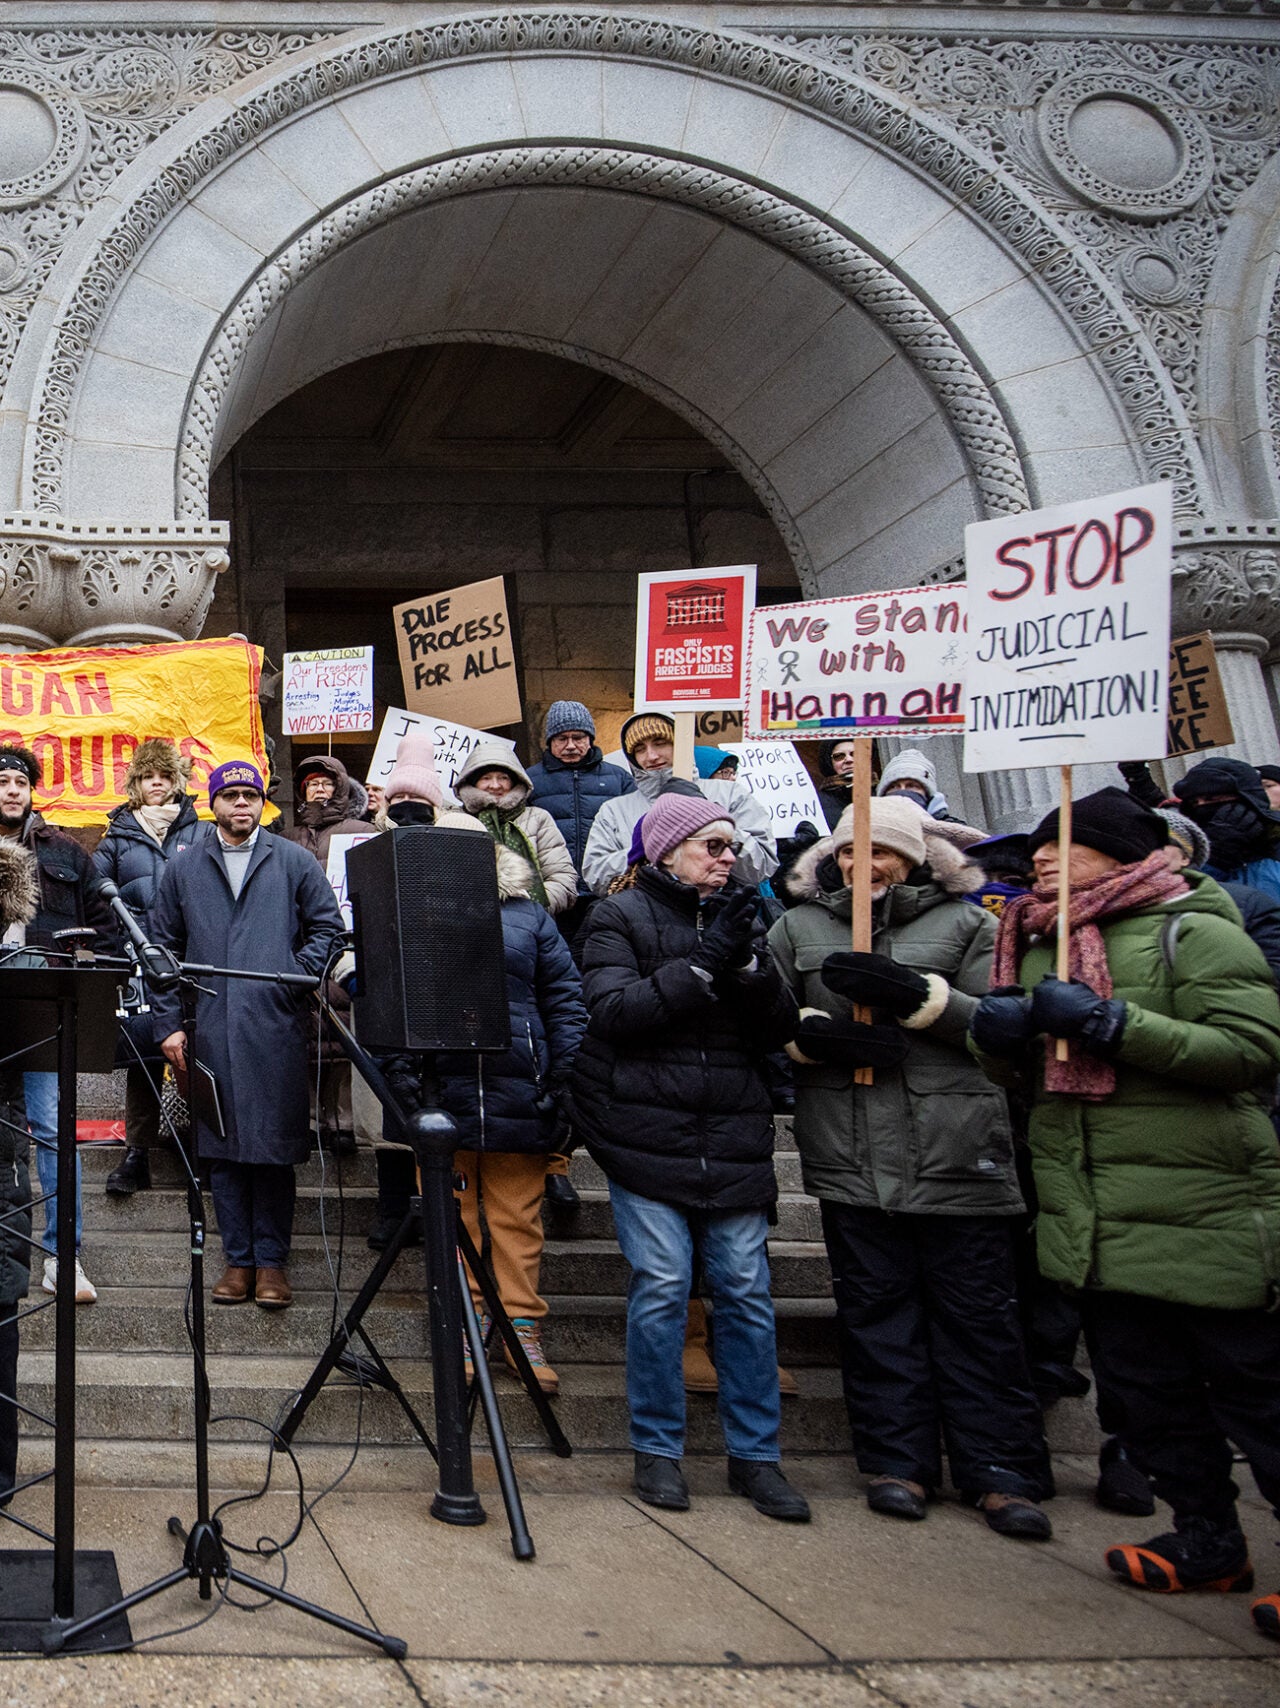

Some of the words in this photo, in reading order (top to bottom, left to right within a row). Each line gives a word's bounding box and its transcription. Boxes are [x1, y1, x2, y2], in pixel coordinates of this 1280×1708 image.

[988, 506, 1155, 602] STOP
[401, 597, 451, 635] DUE
[766, 616, 827, 649] We
[855, 599, 967, 636] Stan
[408, 612, 505, 661] PROCESS
[683, 638, 703, 647] ONLY
[976, 601, 1149, 663] JUDICIAL
[304, 648, 360, 661] CAUTION
[655, 644, 734, 666] FASCISTS
[820, 639, 905, 676] with
[292, 663, 312, 676] Our
[414, 663, 451, 690] FOR
[463, 646, 512, 680] ALL
[655, 665, 693, 676] ARREST
[695, 663, 734, 675] JUDGES
[286, 675, 308, 690] AT
[316, 671, 364, 688] RISK!
[968, 669, 1159, 733] INTIMIDATION!
[288, 714, 326, 733] WHO'S
[328, 712, 372, 730] NEXT?
[730, 748, 796, 768] UPPORT
[741, 771, 808, 794] JUDGE
[769, 799, 817, 821] GAN
